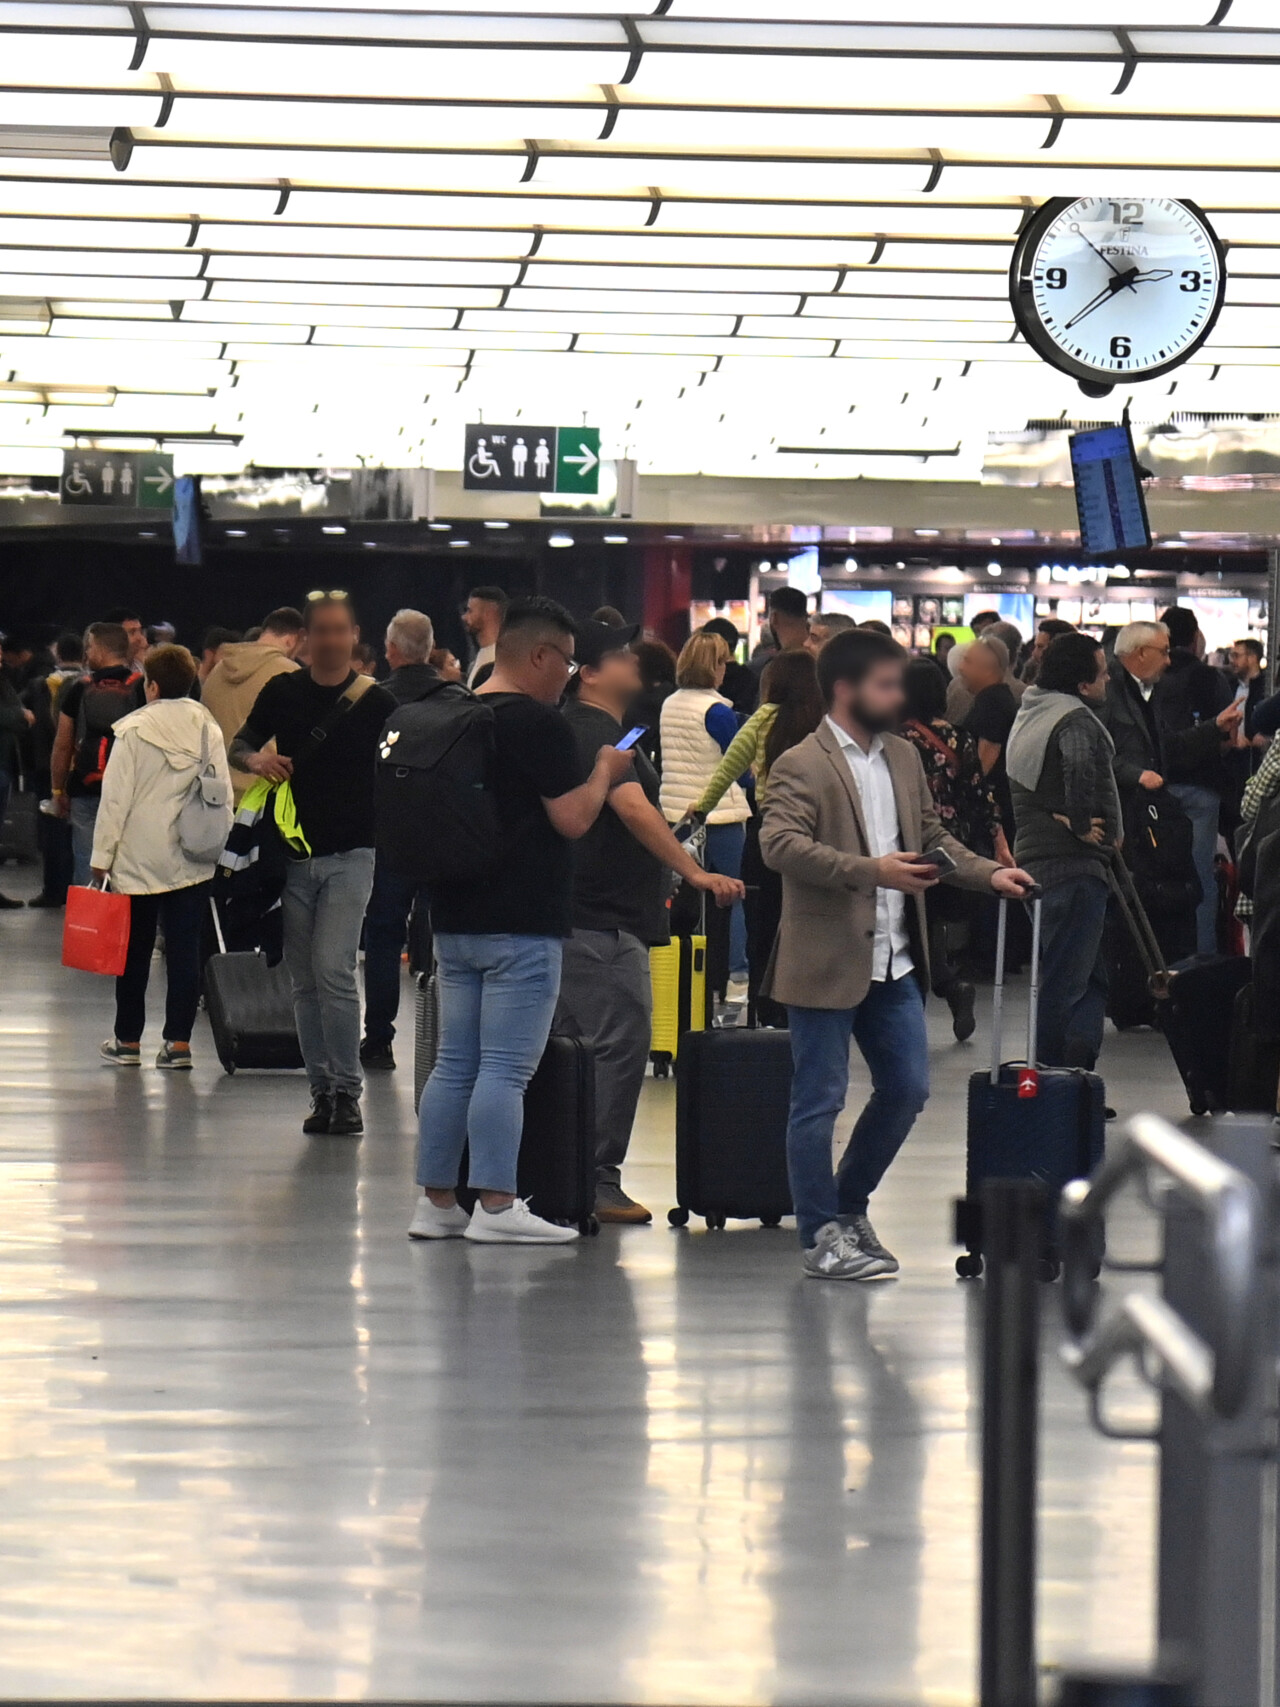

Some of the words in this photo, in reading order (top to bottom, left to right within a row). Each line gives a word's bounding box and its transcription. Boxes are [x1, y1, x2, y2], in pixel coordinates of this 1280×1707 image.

[1109, 203, 1144, 225] 12
[1100, 245, 1148, 256] FESTINA
[1046, 269, 1067, 290] 9
[1180, 271, 1201, 292] 3
[1110, 337, 1131, 358] 6
[492, 435, 507, 445] WC
